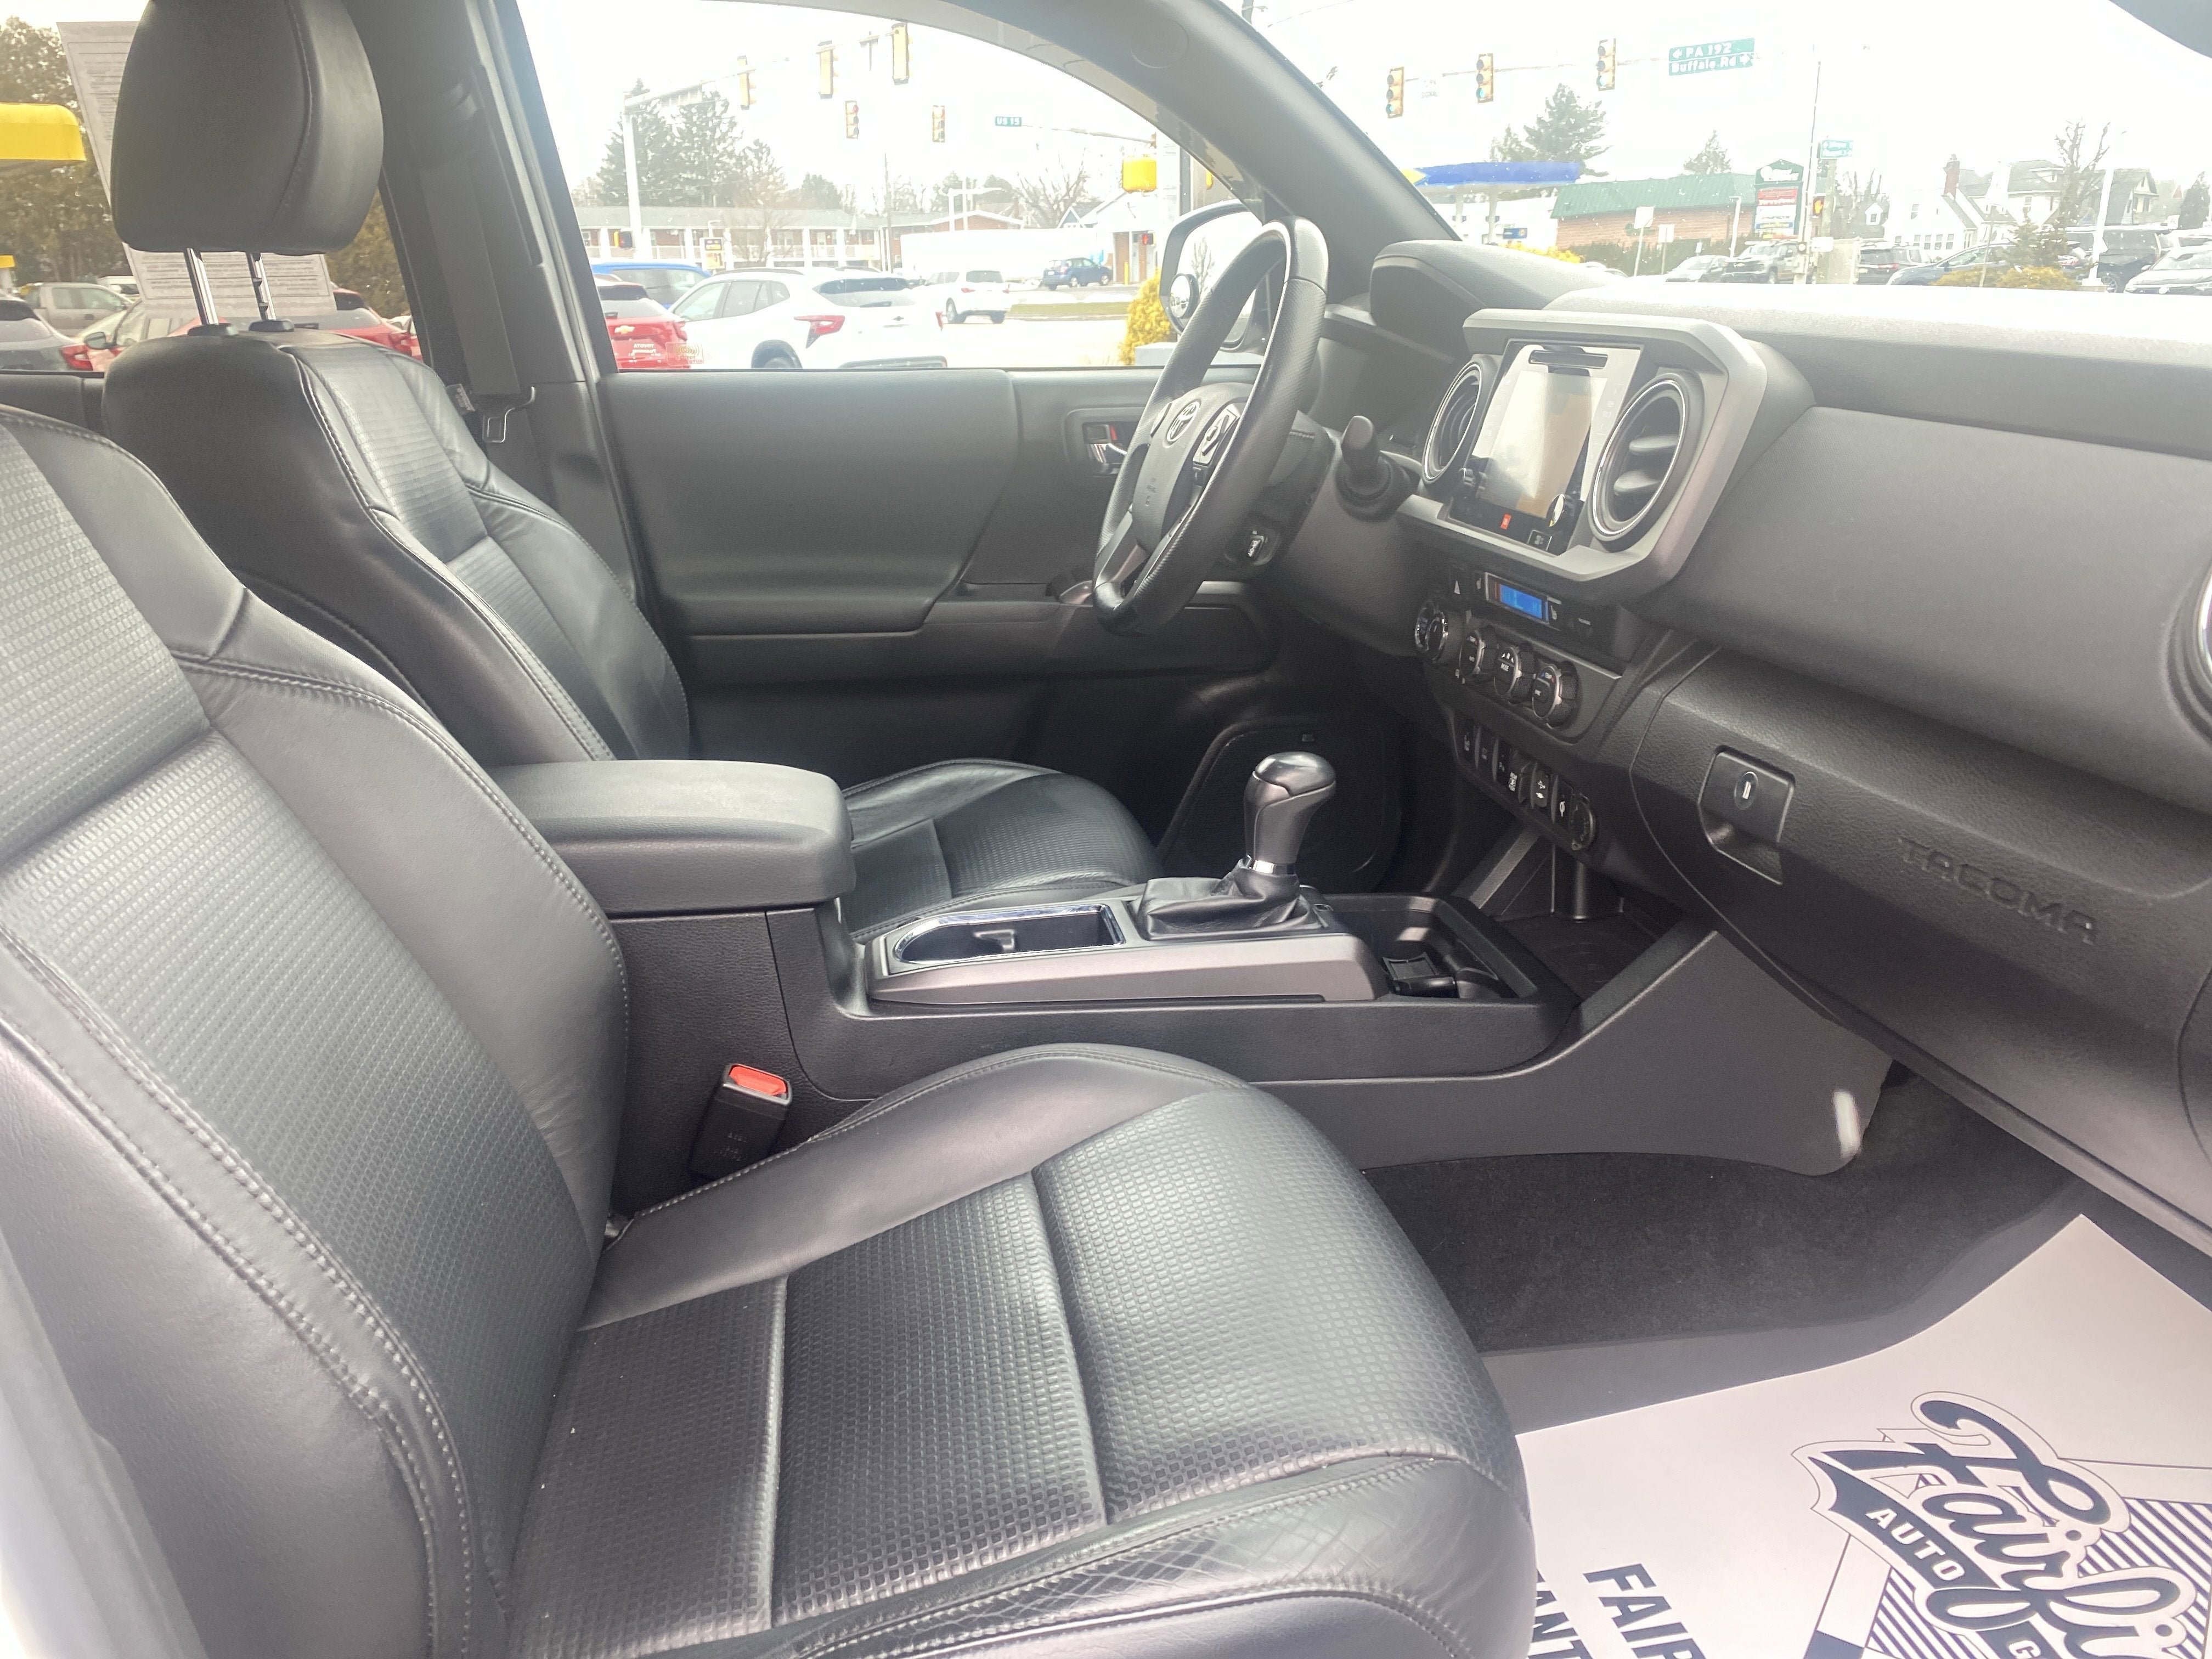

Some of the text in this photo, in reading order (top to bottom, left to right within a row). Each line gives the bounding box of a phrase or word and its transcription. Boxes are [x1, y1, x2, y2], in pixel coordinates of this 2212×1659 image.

[1672, 56, 1736, 72] Buffalo Rd
[1686, 42, 1732, 58] PA 192
[1898, 837, 2097, 945] TACOMA
[1865, 1509, 1965, 1581] AUTO
